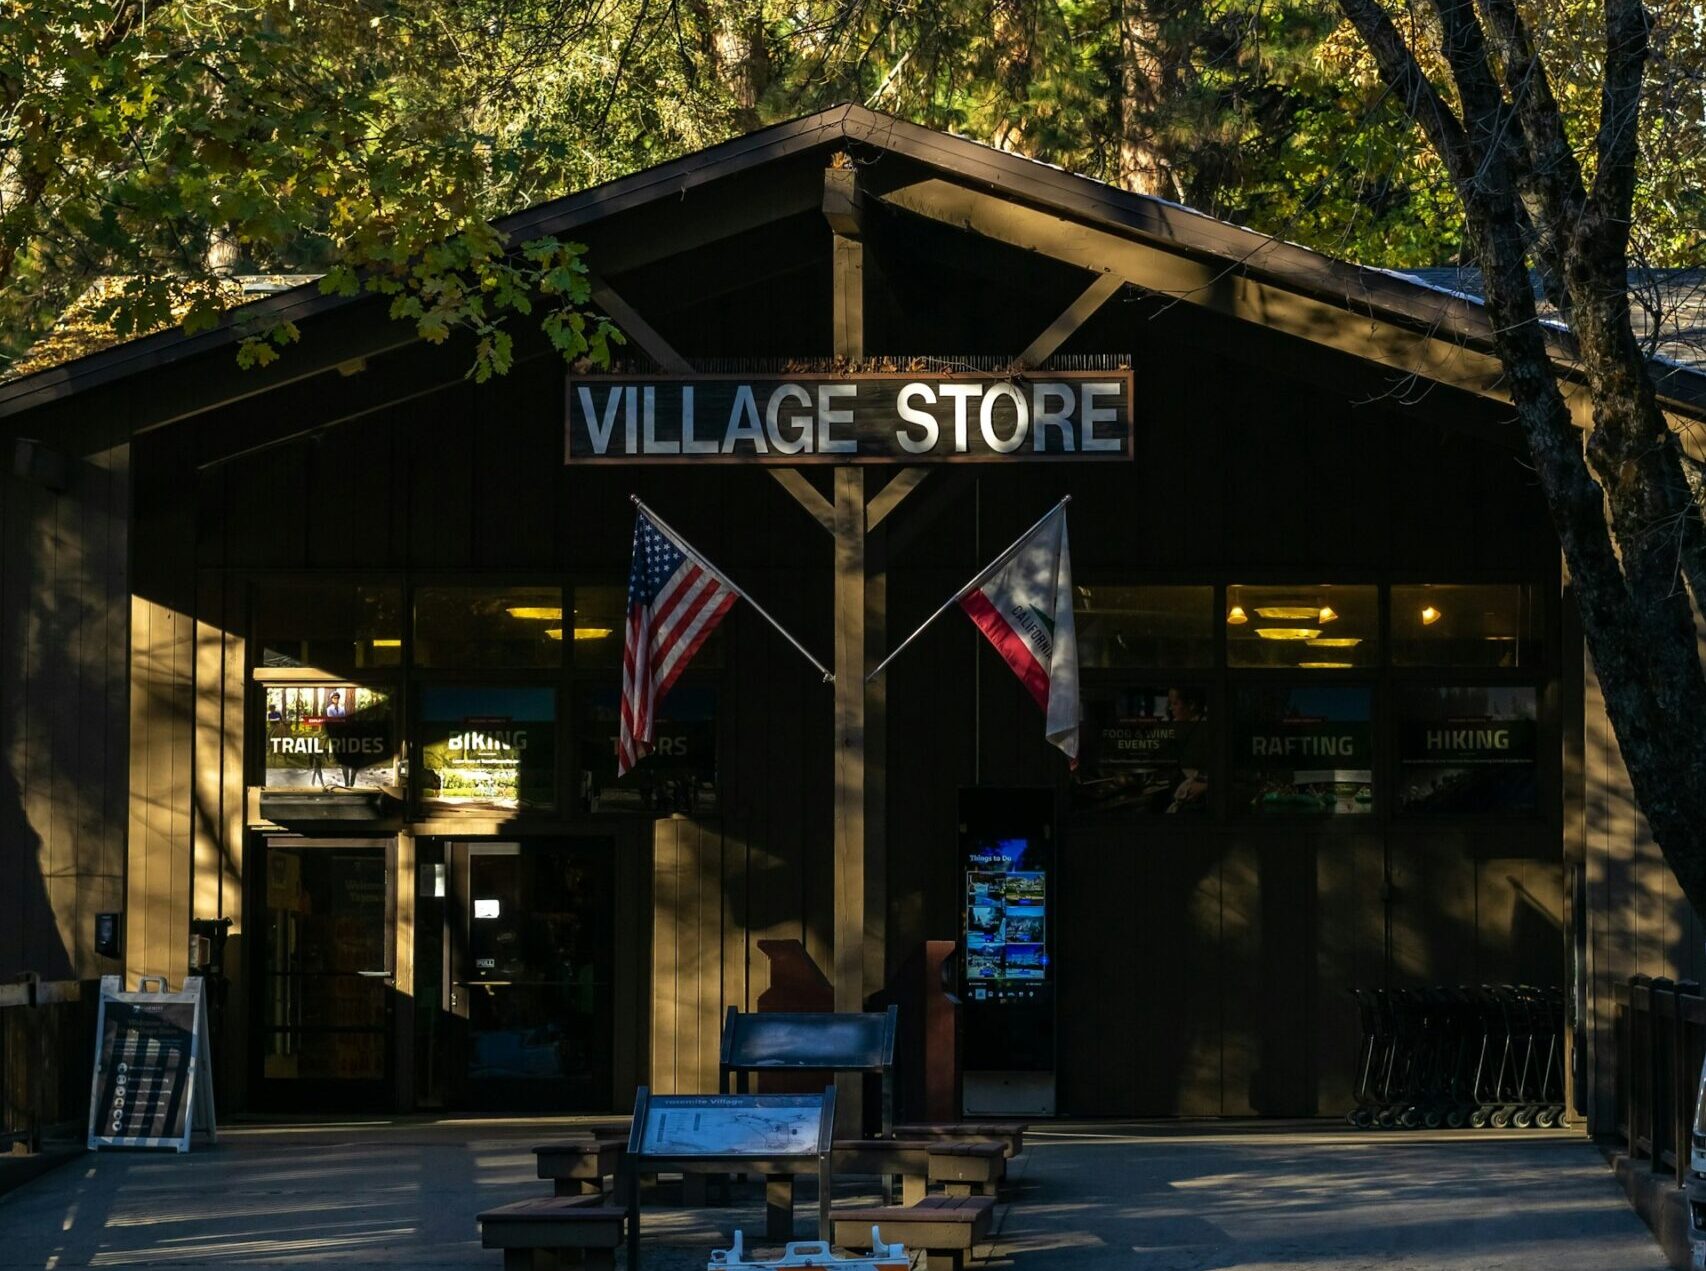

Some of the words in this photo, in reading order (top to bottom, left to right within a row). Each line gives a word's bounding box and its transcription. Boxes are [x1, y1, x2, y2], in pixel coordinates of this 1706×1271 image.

[577, 383, 858, 455] VILLAGE
[896, 383, 1122, 455] STORE
[448, 730, 528, 750] BIKING
[1103, 729, 1131, 739] FOOD
[1146, 729, 1176, 739] WINE
[1426, 729, 1510, 750] HIKING
[270, 737, 323, 754] TRAIL
[329, 737, 384, 754] RIDES
[609, 736, 687, 756] TRS
[1118, 740, 1160, 750] EVENTS
[1252, 736, 1354, 756] RAFTING
[969, 854, 992, 863] Things
[710, 1098, 743, 1106] Village
